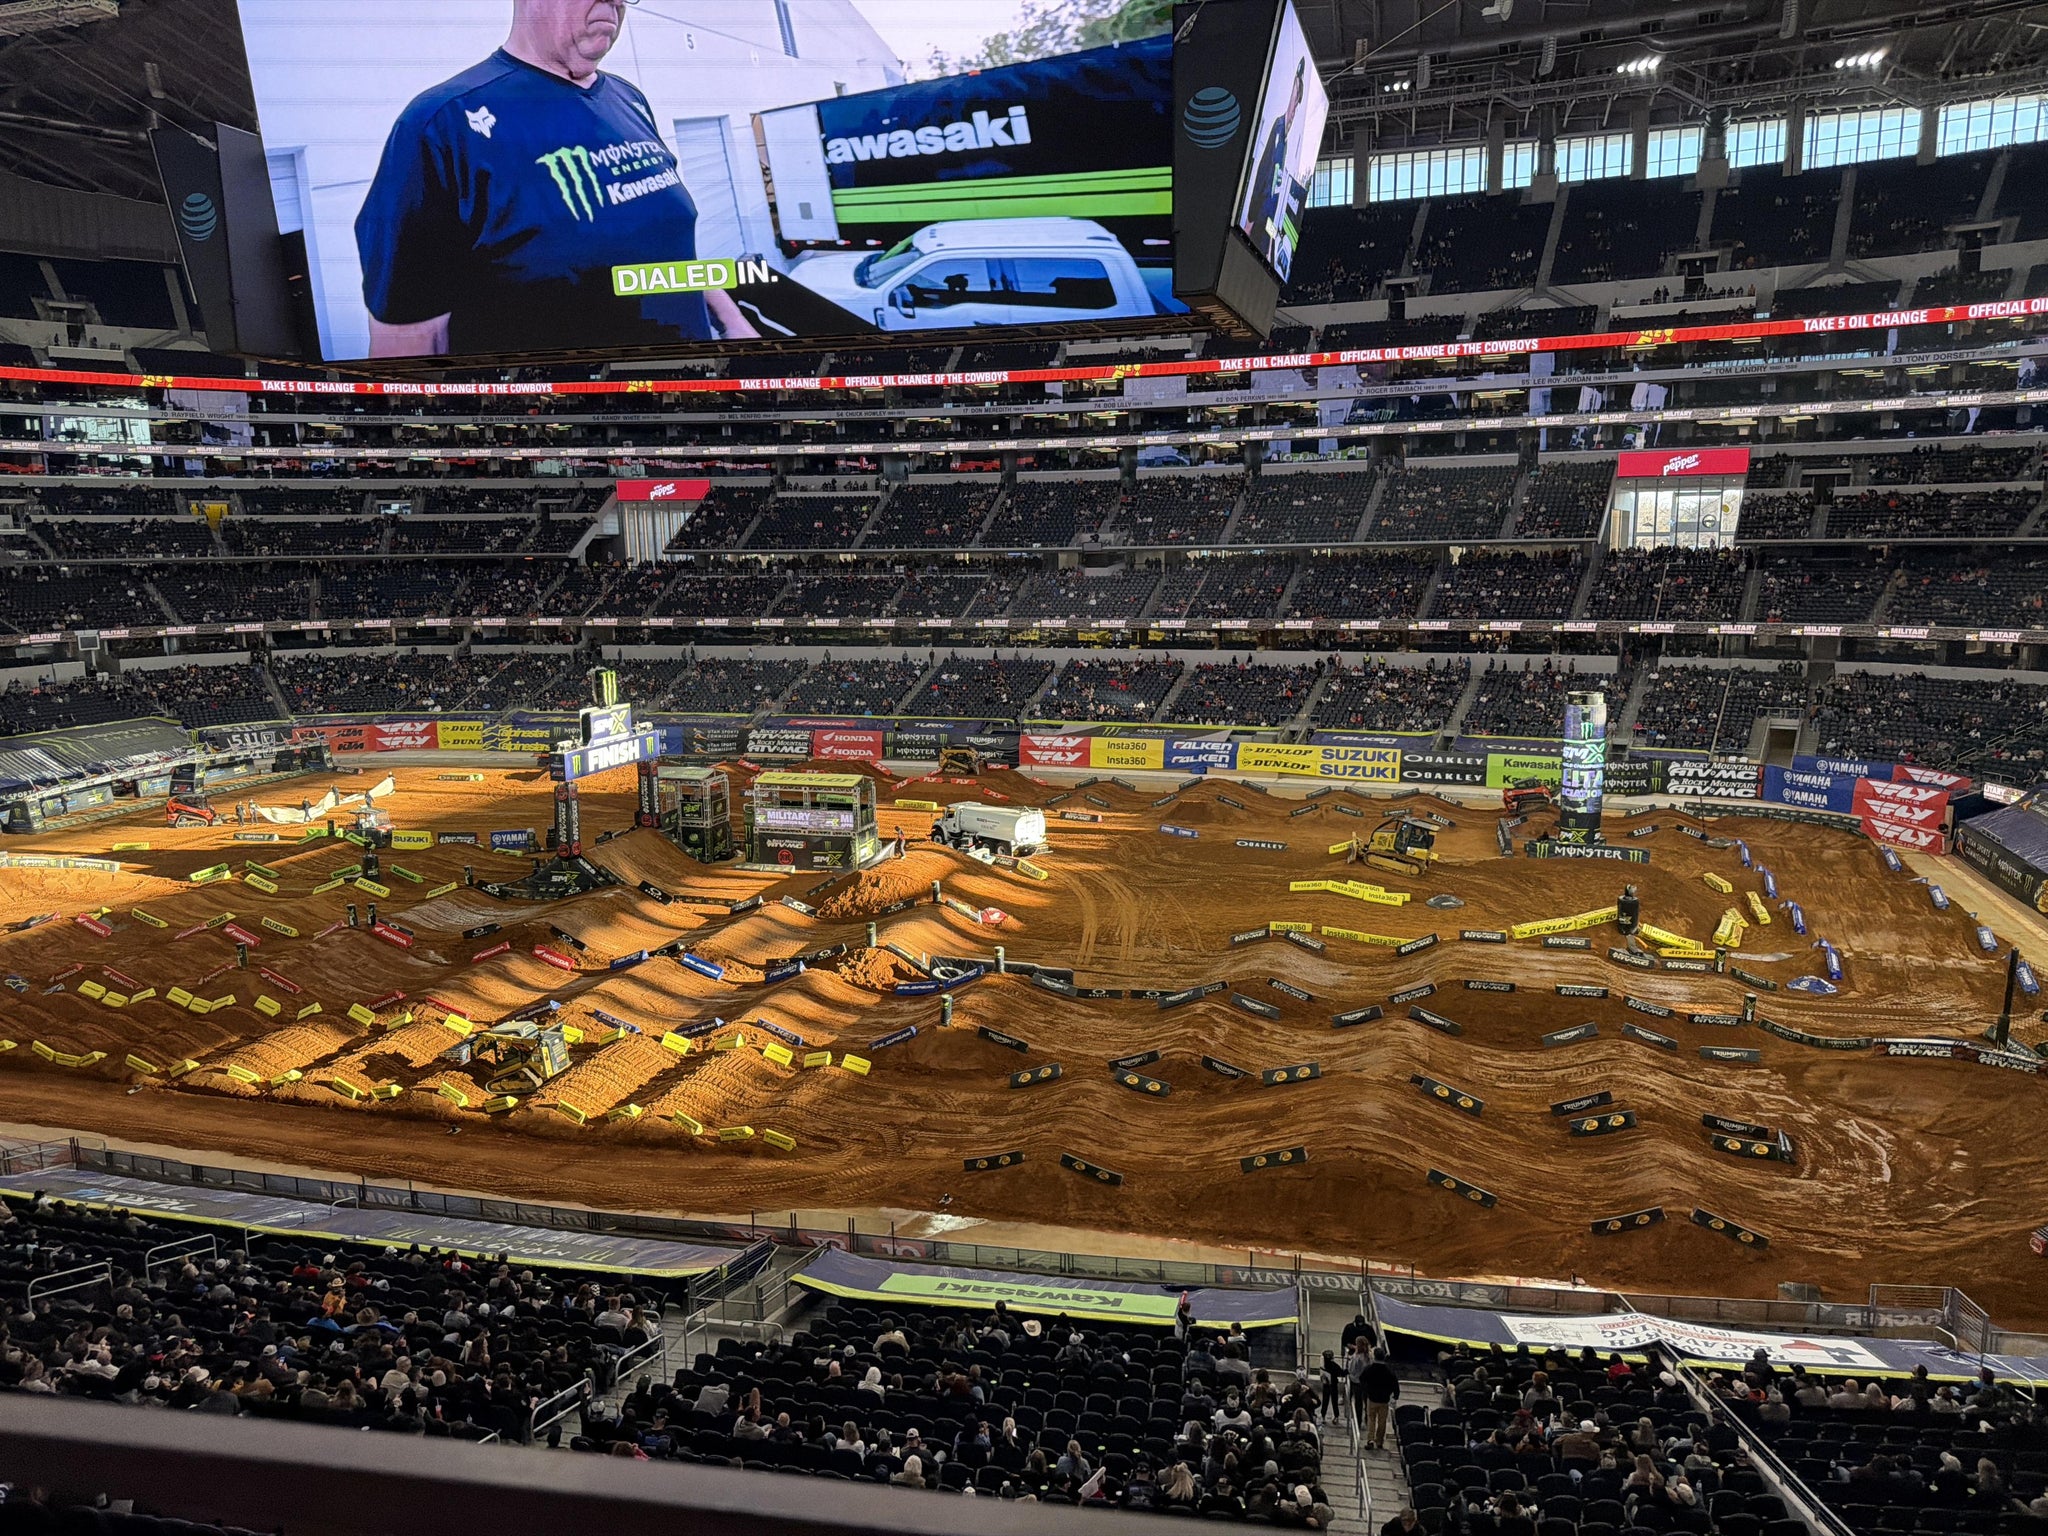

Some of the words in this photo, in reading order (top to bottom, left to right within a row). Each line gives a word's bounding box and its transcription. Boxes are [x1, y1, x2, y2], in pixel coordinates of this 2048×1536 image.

[825, 105, 1031, 165] awasaki
[611, 156, 664, 176] ENERGY
[617, 263, 728, 292] DIALED
[737, 260, 778, 284] IN.
[1968, 301, 2028, 318] OFFICIAL
[1803, 318, 1835, 332] TAKE
[1837, 317, 1845, 328] 5
[1848, 316, 1869, 328] OIL
[1872, 310, 1928, 326] CHANGE
[1340, 350, 1382, 362] OFFICIAL
[1385, 348, 1400, 360] OIL
[1402, 346, 1444, 358] CHANGE
[1447, 344, 1460, 355] OF
[1463, 343, 1482, 354] THE
[1484, 340, 1538, 353] COWBOYS
[1933, 351, 1976, 360] DORSETT
[1220, 360, 1243, 370] TAKE
[1245, 359, 1250, 368] 5
[1253, 358, 1268, 368] OIL
[1270, 355, 1311, 367] CHANGE
[1735, 366, 1768, 374] LANDRY
[740, 380, 761, 389] TAKE
[762, 380, 768, 388] 5
[770, 380, 783, 388] OIL
[785, 378, 820, 388] CHANGE
[845, 376, 881, 386] OFFICIAL
[882, 376, 896, 385] OIL
[898, 374, 932, 385] CHANGE
[934, 374, 946, 384] OF
[948, 373, 963, 384] THE
[965, 372, 1008, 383] COWBOYS
[262, 382, 286, 391] TAKE
[288, 382, 295, 391] 5
[297, 382, 313, 392] OIL
[315, 383, 356, 392] CHANGE
[383, 384, 423, 394] OFFICIAL
[424, 384, 440, 394] OIL
[441, 384, 478, 394] CHANGE
[480, 384, 490, 394] OF
[492, 384, 508, 393] THE
[510, 383, 552, 393] COWBOYS
[1663, 454, 1699, 476] pepper
[650, 483, 675, 500] pepper
[1980, 631, 2021, 639] MILITARY
[231, 732, 260, 746] 5.11
[375, 736, 431, 746] FLY
[896, 734, 936, 742] MONSTER
[966, 736, 997, 744] TRIUMPH
[1027, 736, 1084, 747] FLY
[1107, 742, 1146, 750] Insta360
[1172, 741, 1232, 750] FALKEN
[1254, 747, 1313, 756] DUNLOP
[588, 739, 641, 772] FINISH
[1026, 751, 1083, 762] FLY
[1106, 756, 1146, 765] Insta360
[1171, 754, 1230, 763] FALKEN
[1321, 748, 1398, 763] SUZUKI
[1424, 755, 1484, 765] OAKLEY
[1562, 744, 1604, 764] SMX
[1253, 760, 1310, 769] DUNLOP
[1504, 758, 1562, 770] Kawasaki
[1682, 760, 1710, 768] ROCKY
[1711, 762, 1759, 770] MOUNTAIN
[1828, 761, 1868, 775] YAMAHA
[1320, 764, 1396, 779] SUZUKI
[1424, 772, 1483, 781] OAKLEY
[1904, 768, 1962, 786] FLY
[1681, 778, 1709, 786] ROCKY
[1710, 780, 1756, 789] MOUNTAIN
[1792, 772, 1831, 788] YAMAHA
[1866, 780, 1942, 800] FLY
[1790, 790, 1828, 805] YAMAHA
[767, 811, 810, 822] MILITARY
[1863, 799, 1936, 820] FLY
[393, 835, 429, 844] SUZUKI
[1870, 819, 1935, 846] FLY
[1248, 842, 1283, 850] OAKLEY
[1554, 845, 1622, 860] MONSTER
[812, 853, 842, 866] SMX
[1020, 861, 1041, 877] SUZUKI
[1998, 858, 2022, 880] MONSTER
[250, 875, 276, 891] SUZUKI
[358, 880, 387, 895] SUZUKI
[1294, 881, 1322, 889] Insta360
[1330, 883, 1360, 896] Insta360
[1368, 892, 1398, 902] Insta360
[132, 910, 166, 926] SUZUKI
[82, 917, 106, 934] HONDA
[264, 919, 294, 935] SUZUKI
[1275, 923, 1306, 932] Insta360
[1528, 922, 1574, 936] DUNLOP
[381, 928, 407, 945] HONDA
[1326, 930, 1358, 940] Insta360
[1368, 937, 1401, 947] Insta360
[542, 952, 570, 967] HONDA
[614, 952, 641, 966] FALKEN
[684, 956, 719, 975] WILDPEAK
[600, 1013, 632, 1030] FALKEN
[1341, 1011, 1366, 1022] TRIUMPH
[761, 1022, 795, 1041] FALKEN
[1552, 1030, 1580, 1042] TRIUMPH
[871, 1031, 912, 1050] WILDPEAK
[988, 1030, 1018, 1048] TRIUMPH
[1988, 1053, 2007, 1061] ROCKY
[2007, 1056, 2038, 1068] MOUNTAIN
[1212, 1061, 1238, 1075] TRIUMPH
[1562, 1098, 1596, 1112] TRIUMPH
[1716, 1119, 1748, 1132] TRIUMPH
[430, 1236, 569, 1256] MONSTER
[934, 1282, 1123, 1307] Kawasaki
